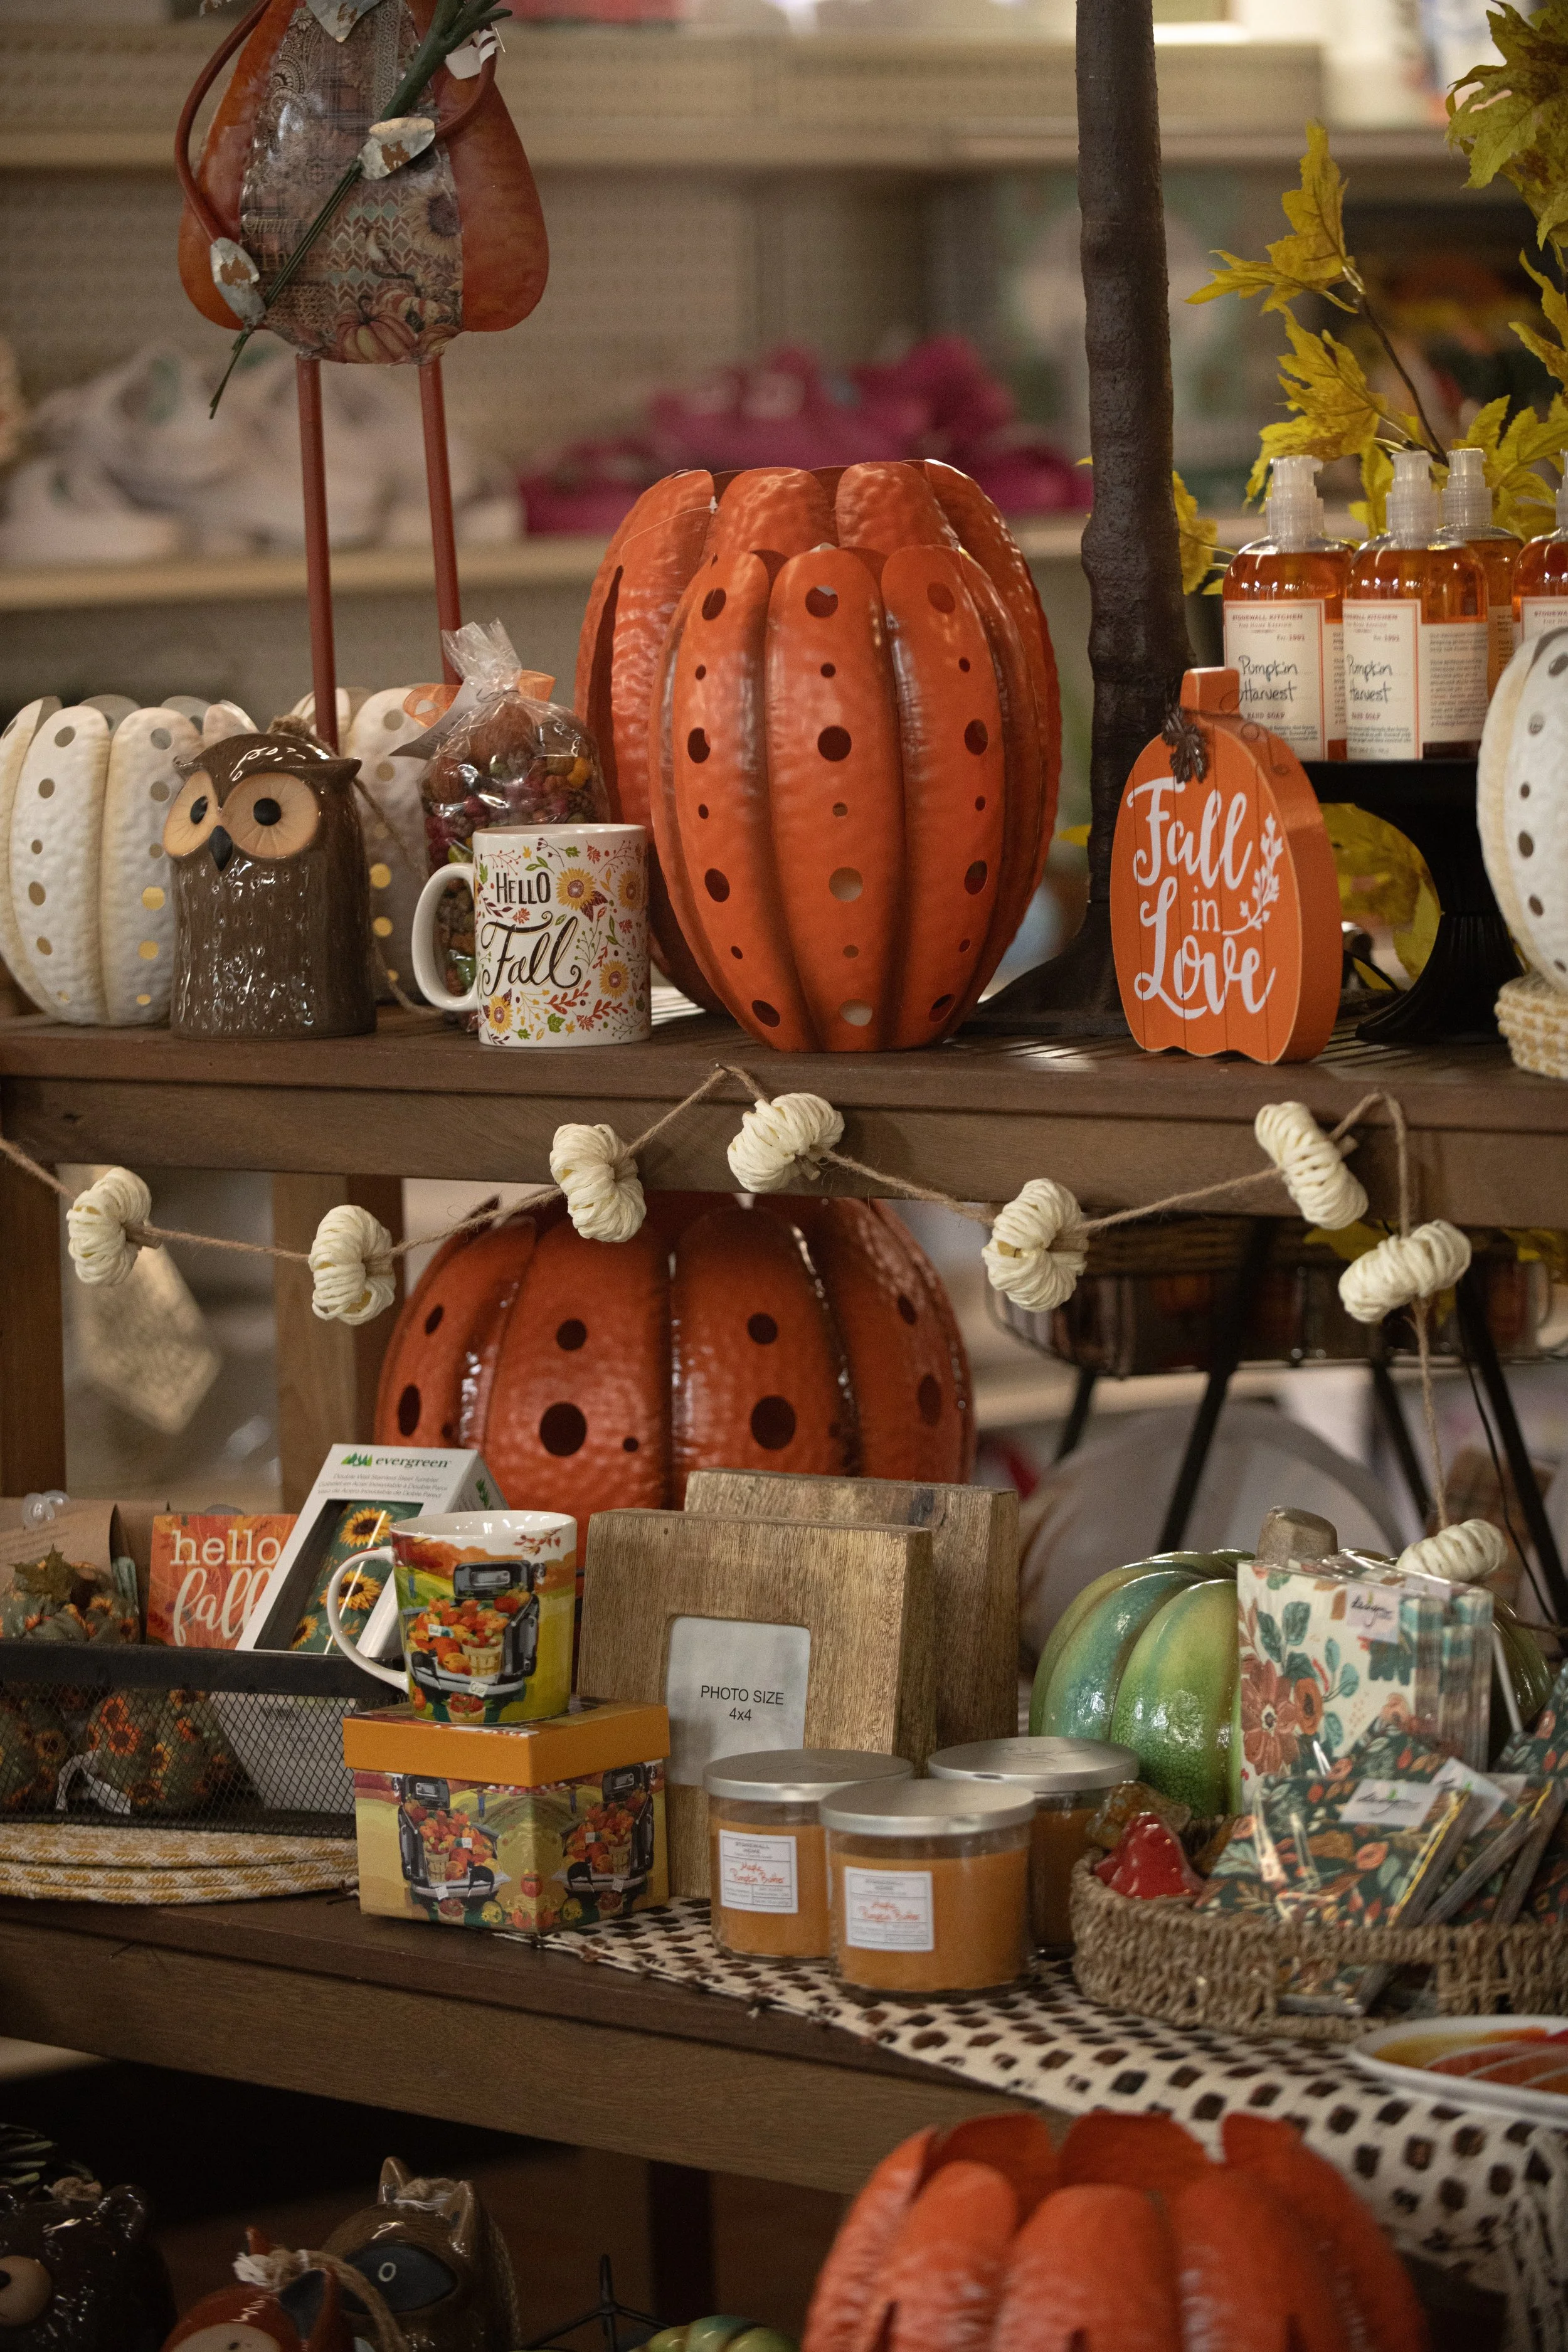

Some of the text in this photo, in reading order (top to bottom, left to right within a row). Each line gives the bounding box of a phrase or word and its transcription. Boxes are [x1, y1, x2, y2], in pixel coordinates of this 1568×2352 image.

[1238, 655, 1298, 682] Pumpkin
[1346, 654, 1393, 682] Pumpkin
[1242, 678, 1297, 703] Harvest
[1350, 678, 1392, 704] Harvest
[1127, 776, 1253, 890] Fall
[495, 872, 551, 904] HELLO
[1192, 885, 1221, 931] in
[480, 911, 582, 997] Fall
[1134, 876, 1276, 1019] Love
[376, 1456, 448, 1468] evergreen
[170, 1528, 282, 1566] hello
[173, 1567, 273, 1647] fall
[701, 1685, 784, 1705] PHOTO SIZE
[729, 1707, 752, 1721] 4x4
